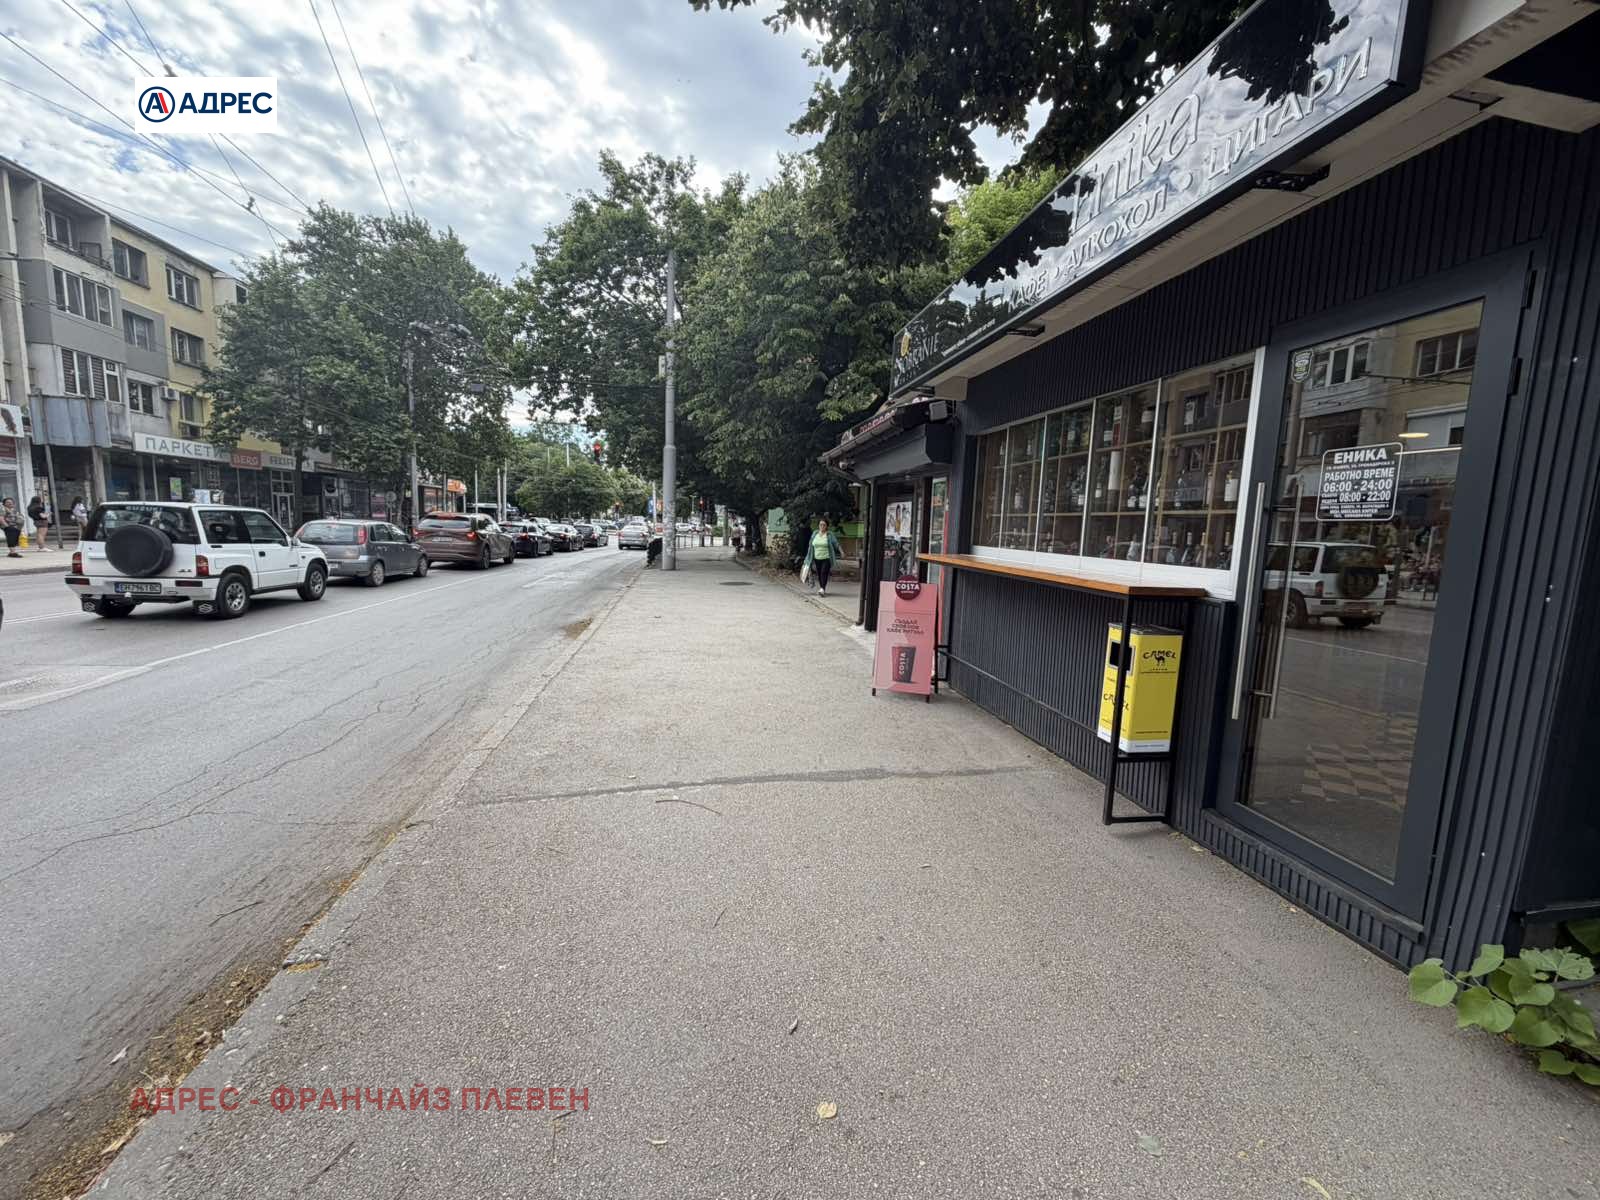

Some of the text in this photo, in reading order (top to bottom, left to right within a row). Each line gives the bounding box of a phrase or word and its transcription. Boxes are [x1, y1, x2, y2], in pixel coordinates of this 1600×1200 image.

[1008, 37, 1373, 312] КАФЕ АЛКОХОЛ ЦИГАРИ
[1333, 448, 1388, 464] ЕНИКА
[1324, 467, 1395, 481] РАБОТНО ВРЕМЕ
[1323, 481, 1352, 493] 06:00
[1360, 479, 1393, 491] 24:00
[1366, 490, 1392, 501] 22:00
[895, 583, 920, 591] COSTA
[1143, 650, 1176, 659] CAMEL
[898, 652, 907, 675] COSTA
